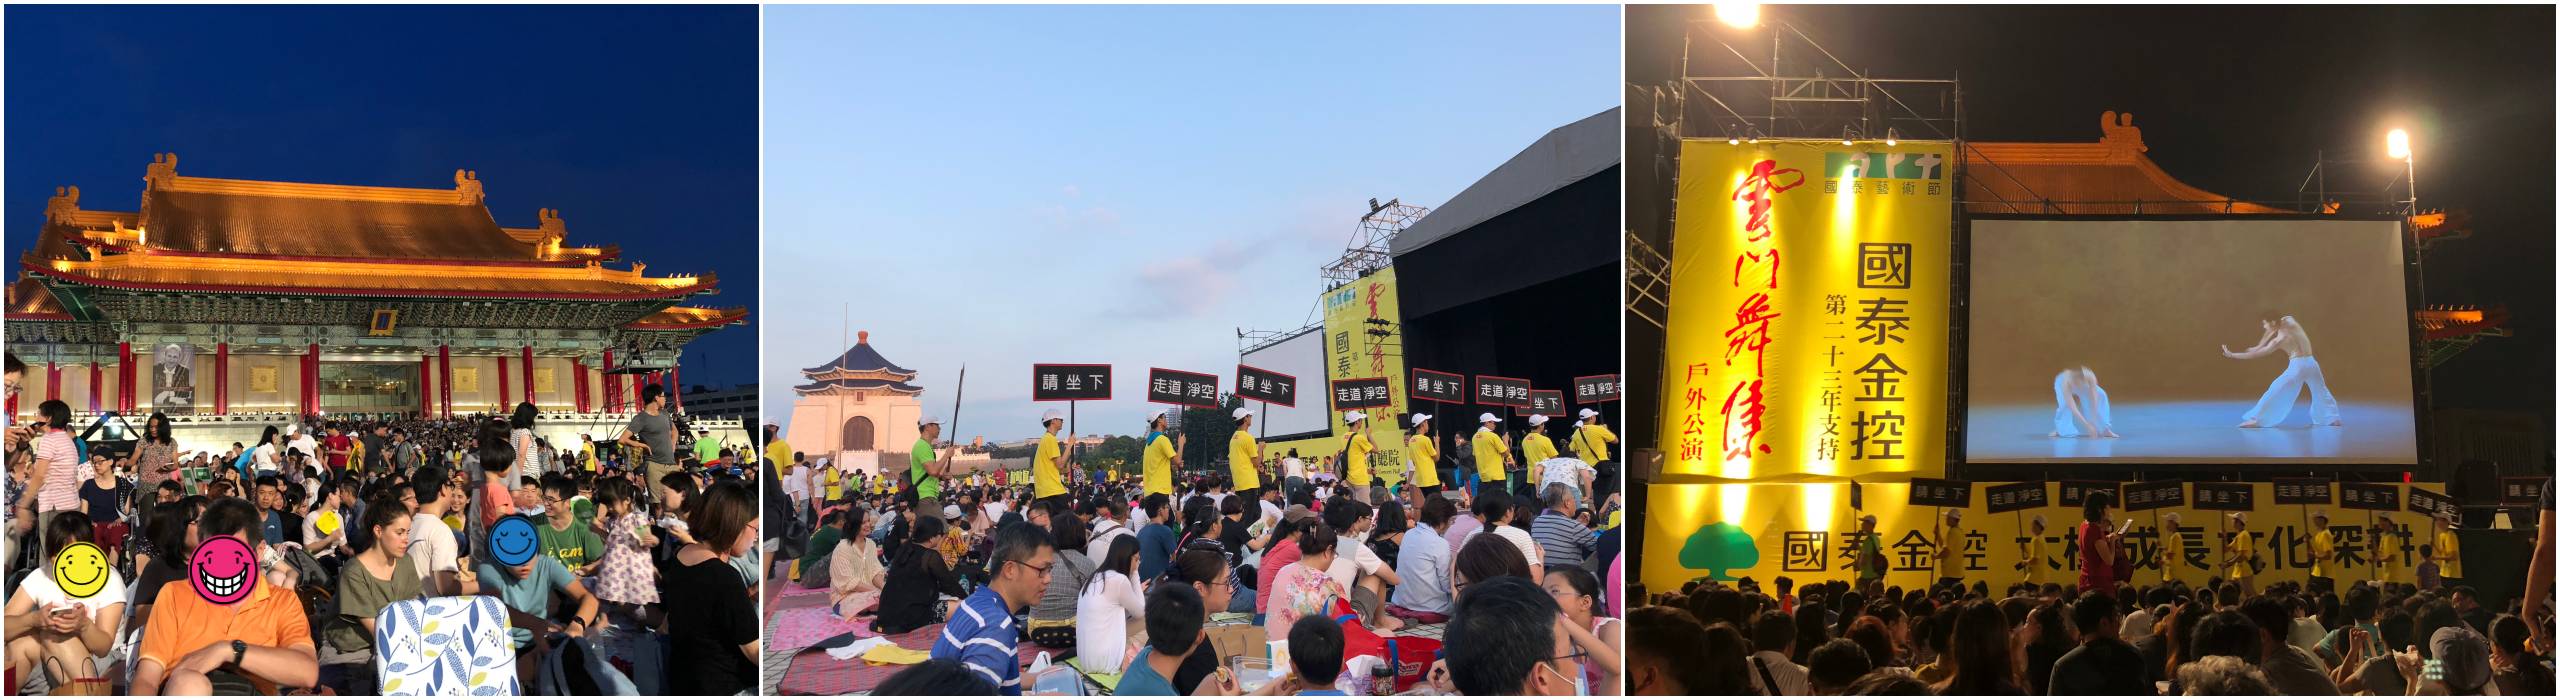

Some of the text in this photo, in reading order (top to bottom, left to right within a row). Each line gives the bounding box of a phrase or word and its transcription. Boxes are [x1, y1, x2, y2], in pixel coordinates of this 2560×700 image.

[1824, 180, 1941, 196] 國泰藝術節
[1850, 242, 1912, 461] 國泰金控
[1042, 373, 1104, 391] 請坐下
[1242, 374, 1290, 396] 請坐下
[1418, 377, 1459, 396] 請坐下
[1817, 294, 1848, 461] 第二十三年支持
[1153, 377, 1215, 399] 走道淨空
[1337, 386, 1387, 402] 走道淨空
[1481, 384, 1528, 400] 走道淨空
[1680, 362, 1709, 461] 戶外公演
